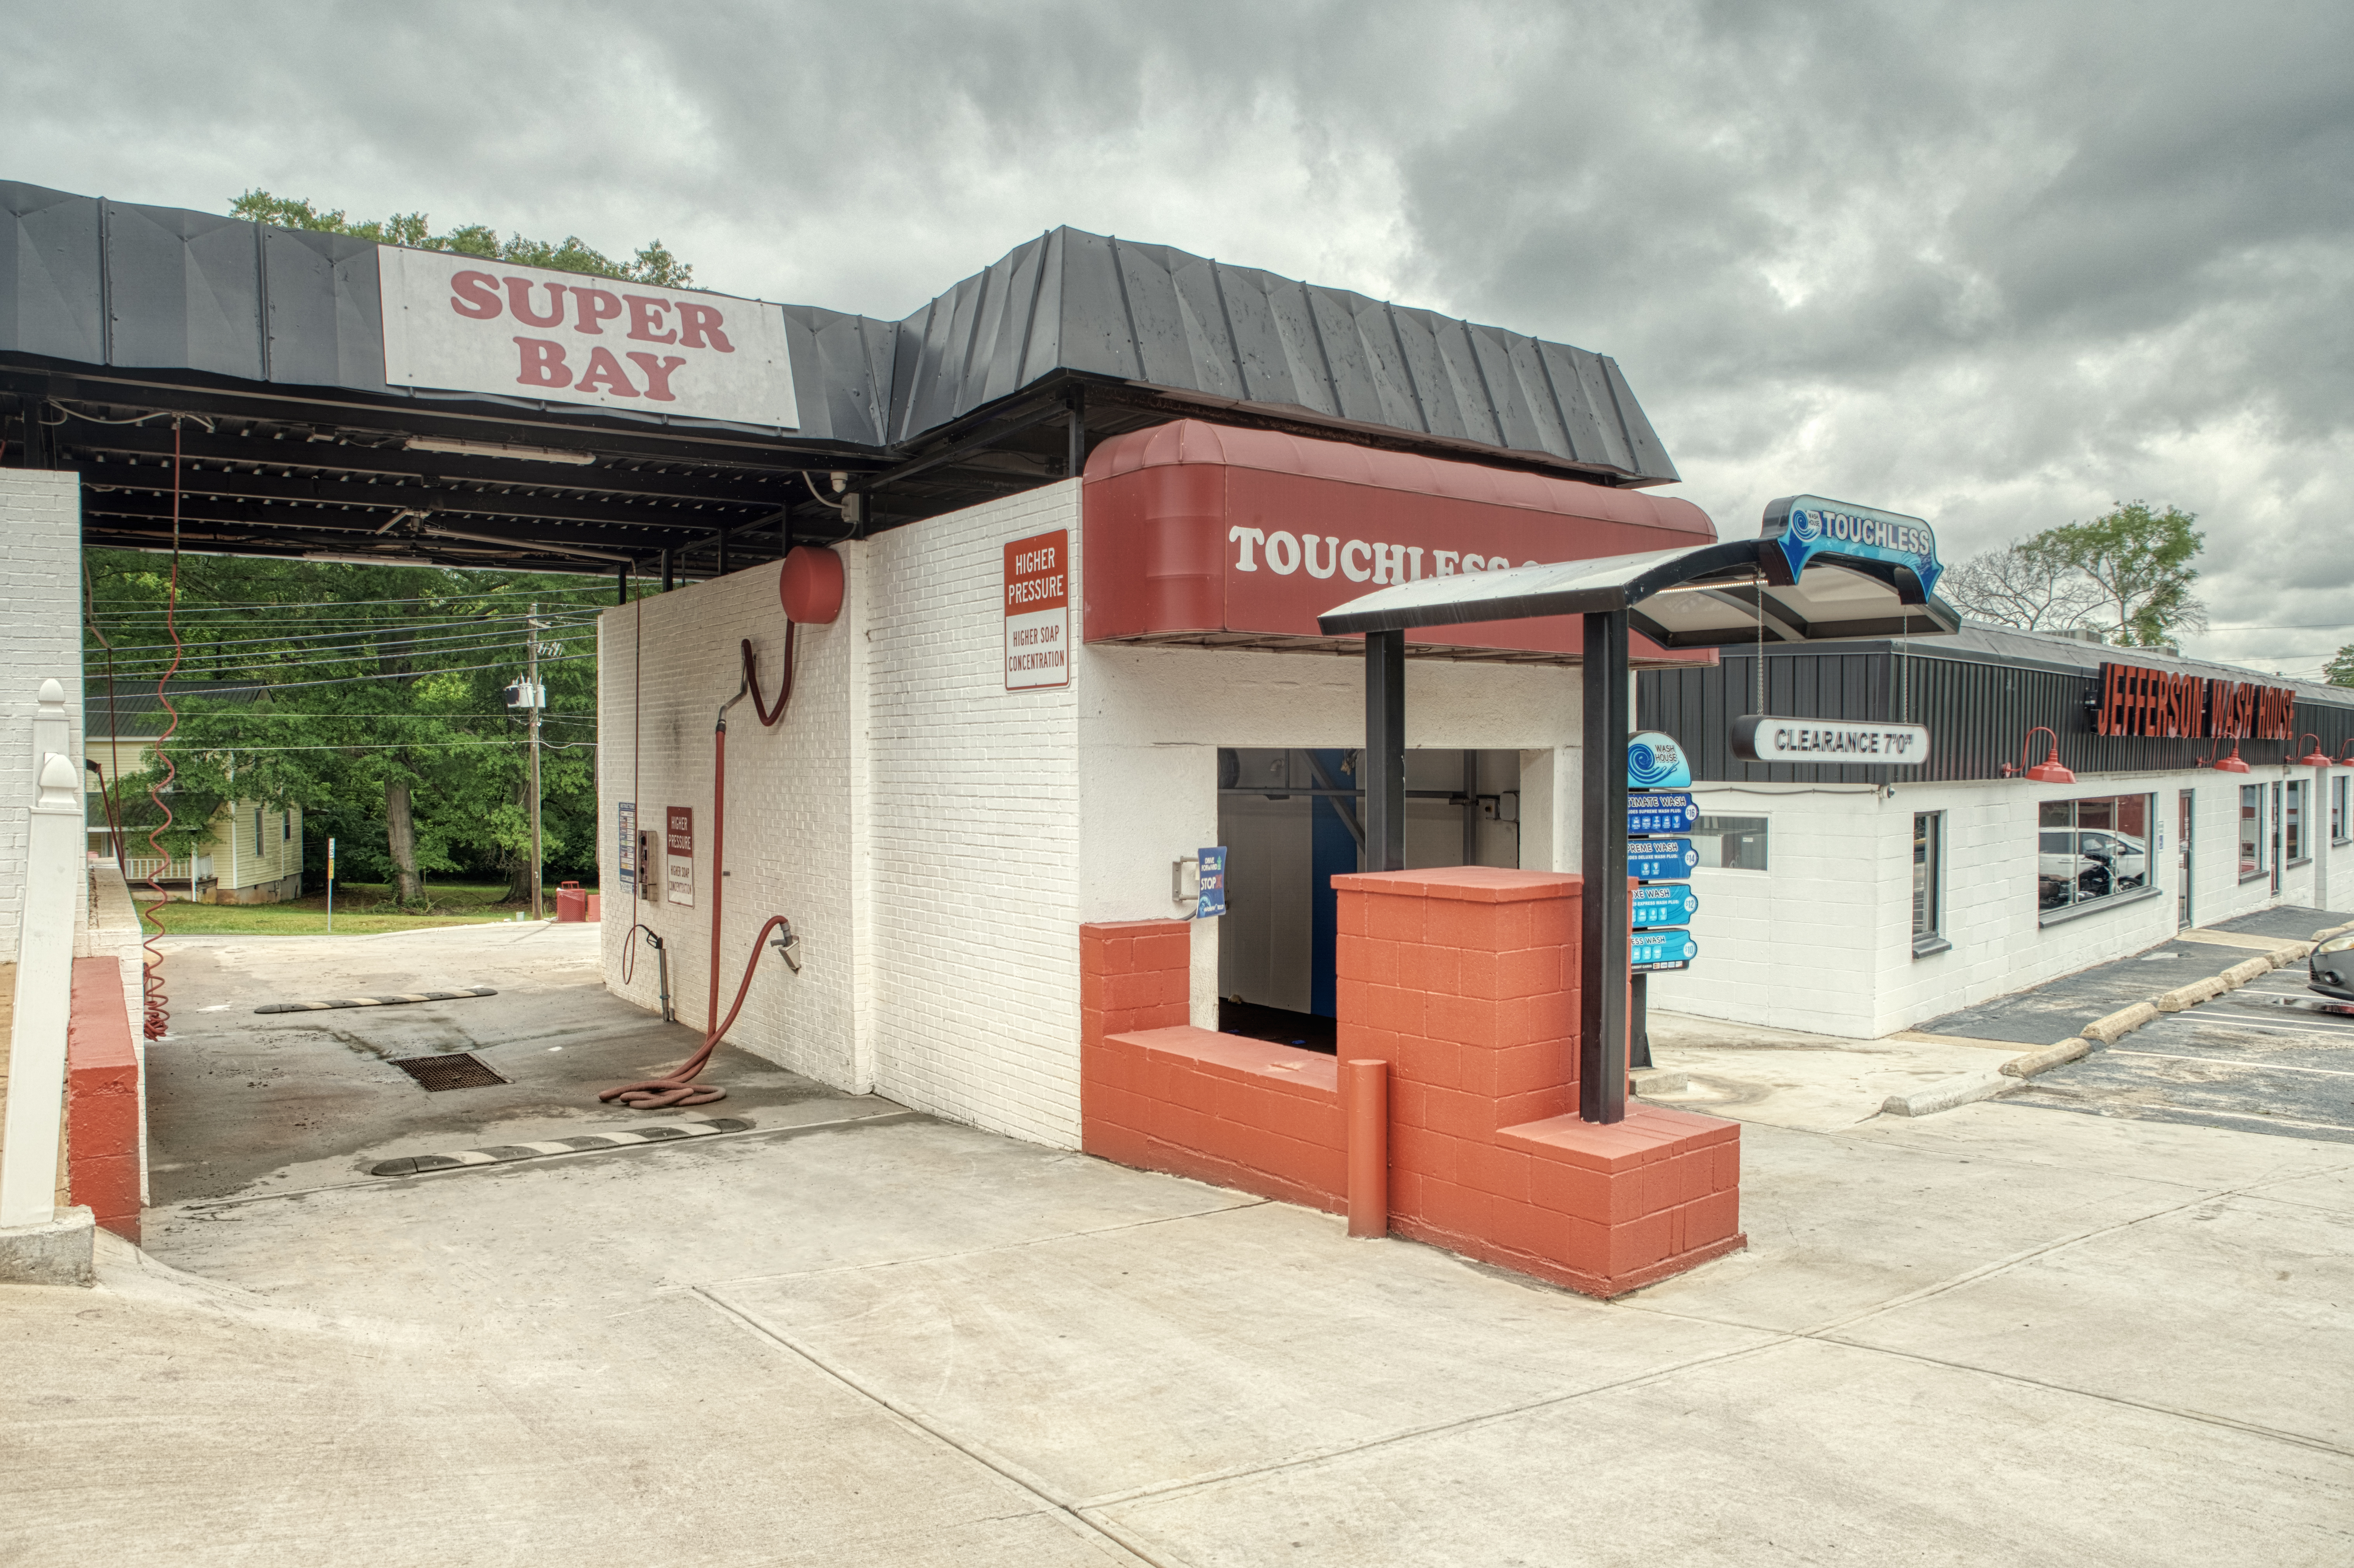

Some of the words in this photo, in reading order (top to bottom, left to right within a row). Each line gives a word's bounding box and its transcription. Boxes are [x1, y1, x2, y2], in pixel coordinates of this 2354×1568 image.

[451, 270, 735, 352] SUPER
[513, 336, 686, 401] BAY
[1822, 510, 1929, 556] TOUCHLESS
[1016, 547, 1055, 575] HIGHER
[1009, 575, 1063, 605] PRESSURE
[1013, 628, 1038, 647] HIGHER
[1041, 625, 1059, 643] SOAP
[1009, 650, 1064, 672] CONCENTRATION
[2098, 662, 2204, 739] JEFFERSON
[2209, 678, 2254, 739] WASH
[2257, 685, 2296, 740] HOUSE
[1774, 729, 1880, 754] CLEARANCE
[1660, 796, 1686, 807] WASH
[671, 816, 687, 831] HIGHER
[669, 834, 691, 850] PRESSURE
[1653, 842, 1678, 853] WASH
[1687, 854, 1695, 863] $14
[671, 865, 681, 877] HIGHER
[669, 880, 691, 895] CONCENTRATION
[1201, 877, 1216, 891] STOP
[1646, 888, 1670, 899] WASH
[1645, 936, 1665, 945] WASH
